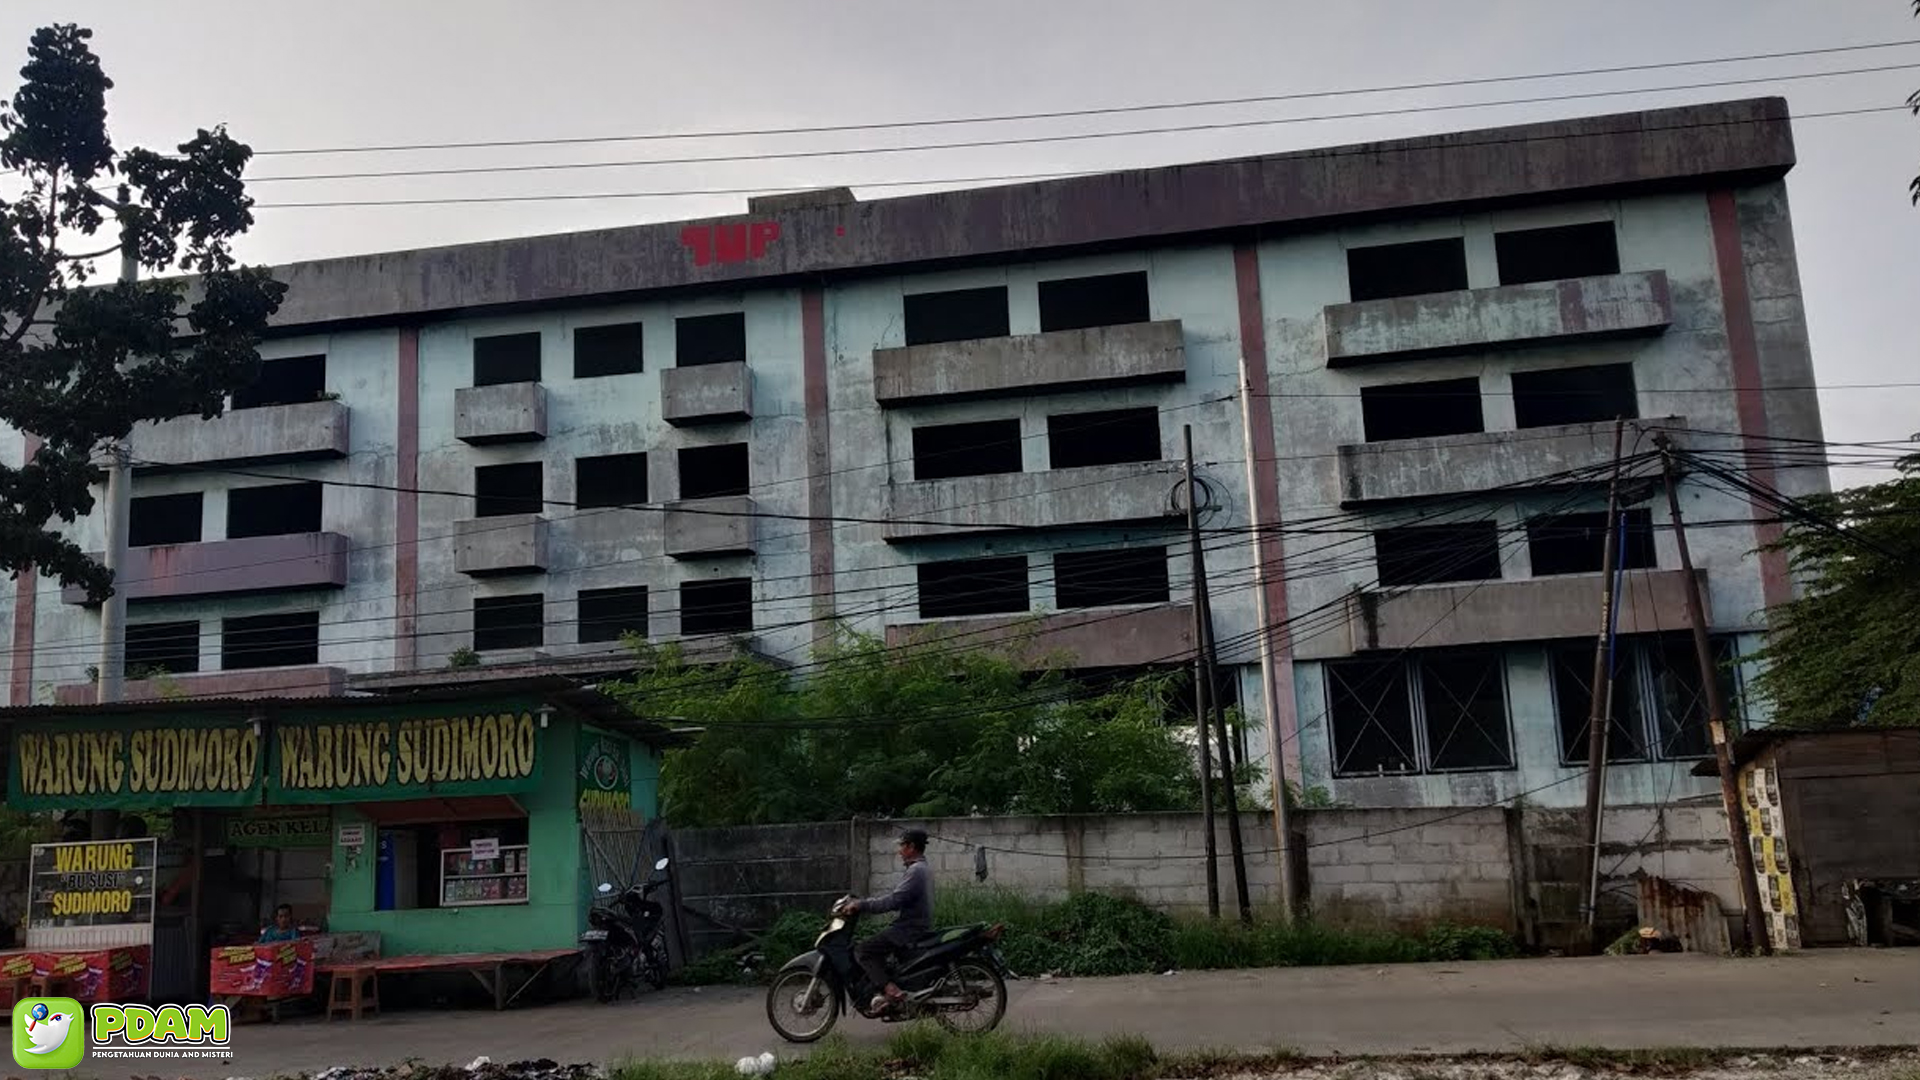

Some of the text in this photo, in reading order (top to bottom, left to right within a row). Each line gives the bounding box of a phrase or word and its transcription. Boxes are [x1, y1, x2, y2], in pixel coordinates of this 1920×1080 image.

[19, 728, 258, 795] WARUNG SUDIMORO
[278, 722, 391, 789] WARUNG
[396, 711, 535, 785] SUDIMORO
[230, 820, 281, 837] AGEN
[55, 843, 133, 873] WARUNG
[52, 890, 132, 915] SUDIMORO
